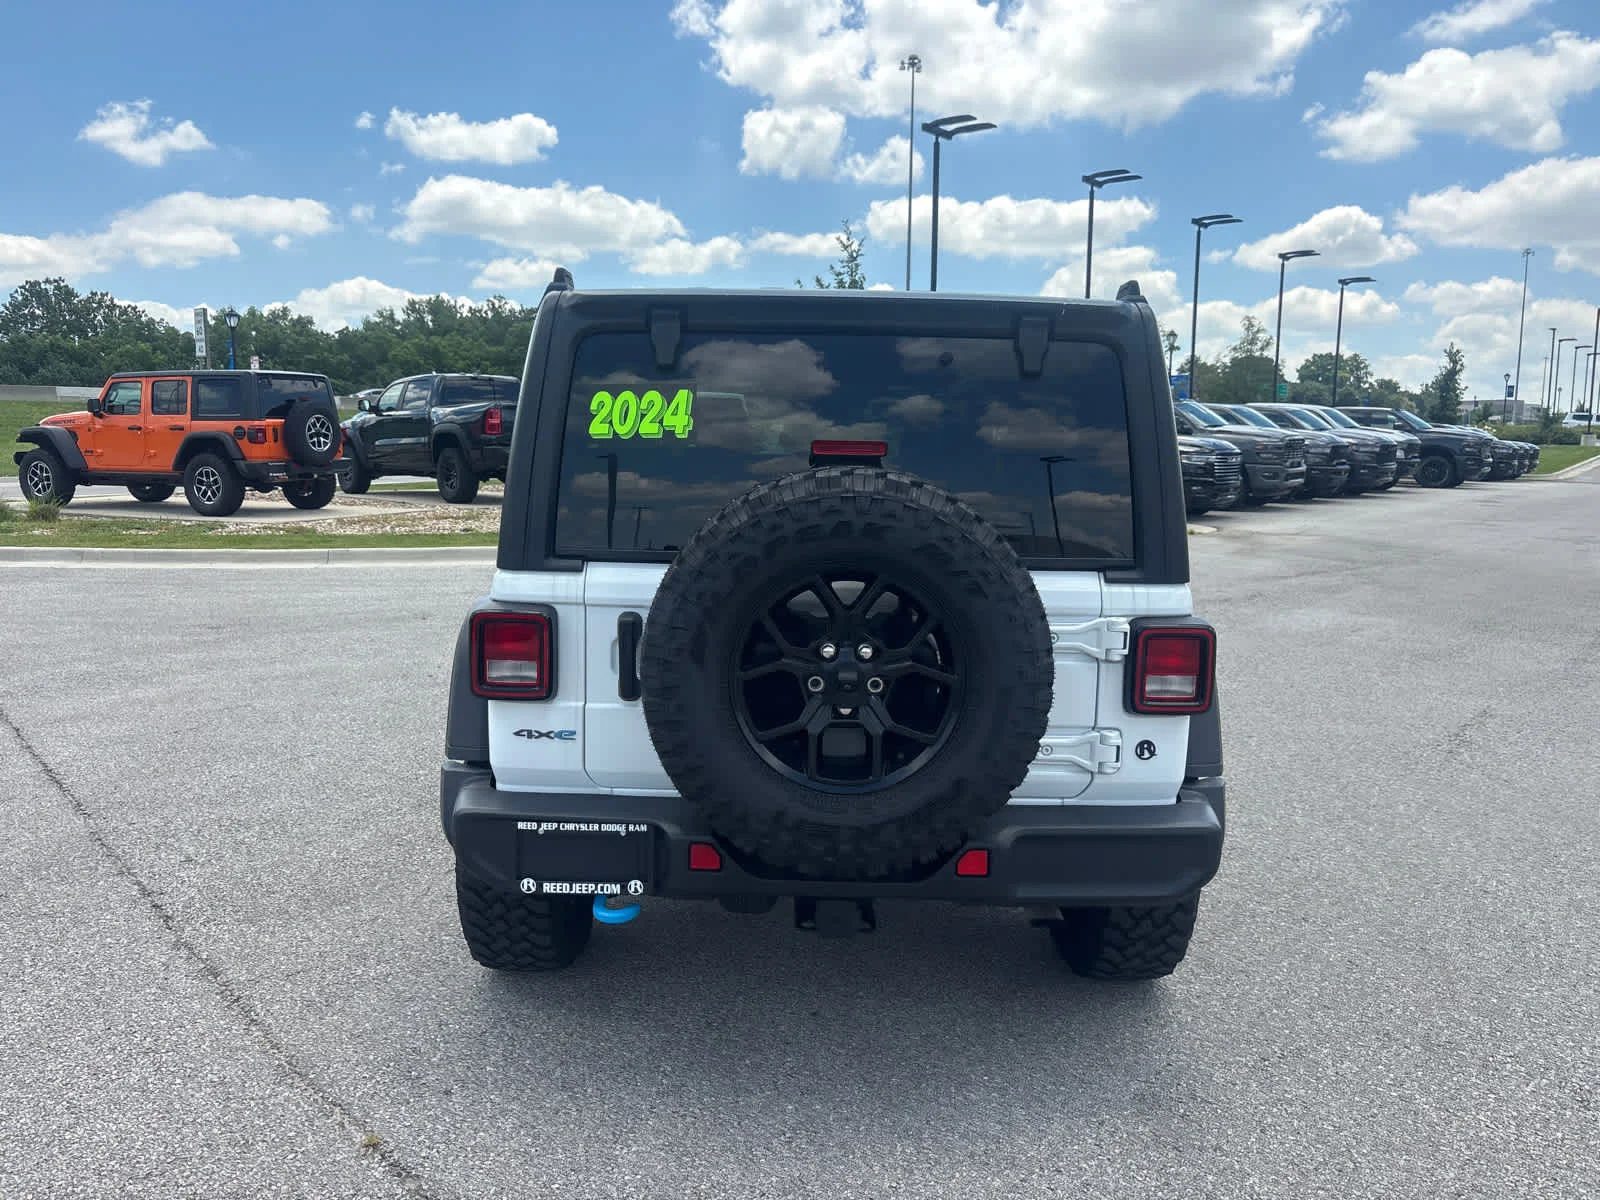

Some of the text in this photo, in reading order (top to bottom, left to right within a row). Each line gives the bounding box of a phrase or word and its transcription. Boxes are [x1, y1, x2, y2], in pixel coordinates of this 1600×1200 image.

[589, 389, 693, 439] 2024
[517, 821, 648, 832] REED JEEP CHRYSLER DODGE RAM
[542, 882, 621, 894] REEDJEEP.COM
